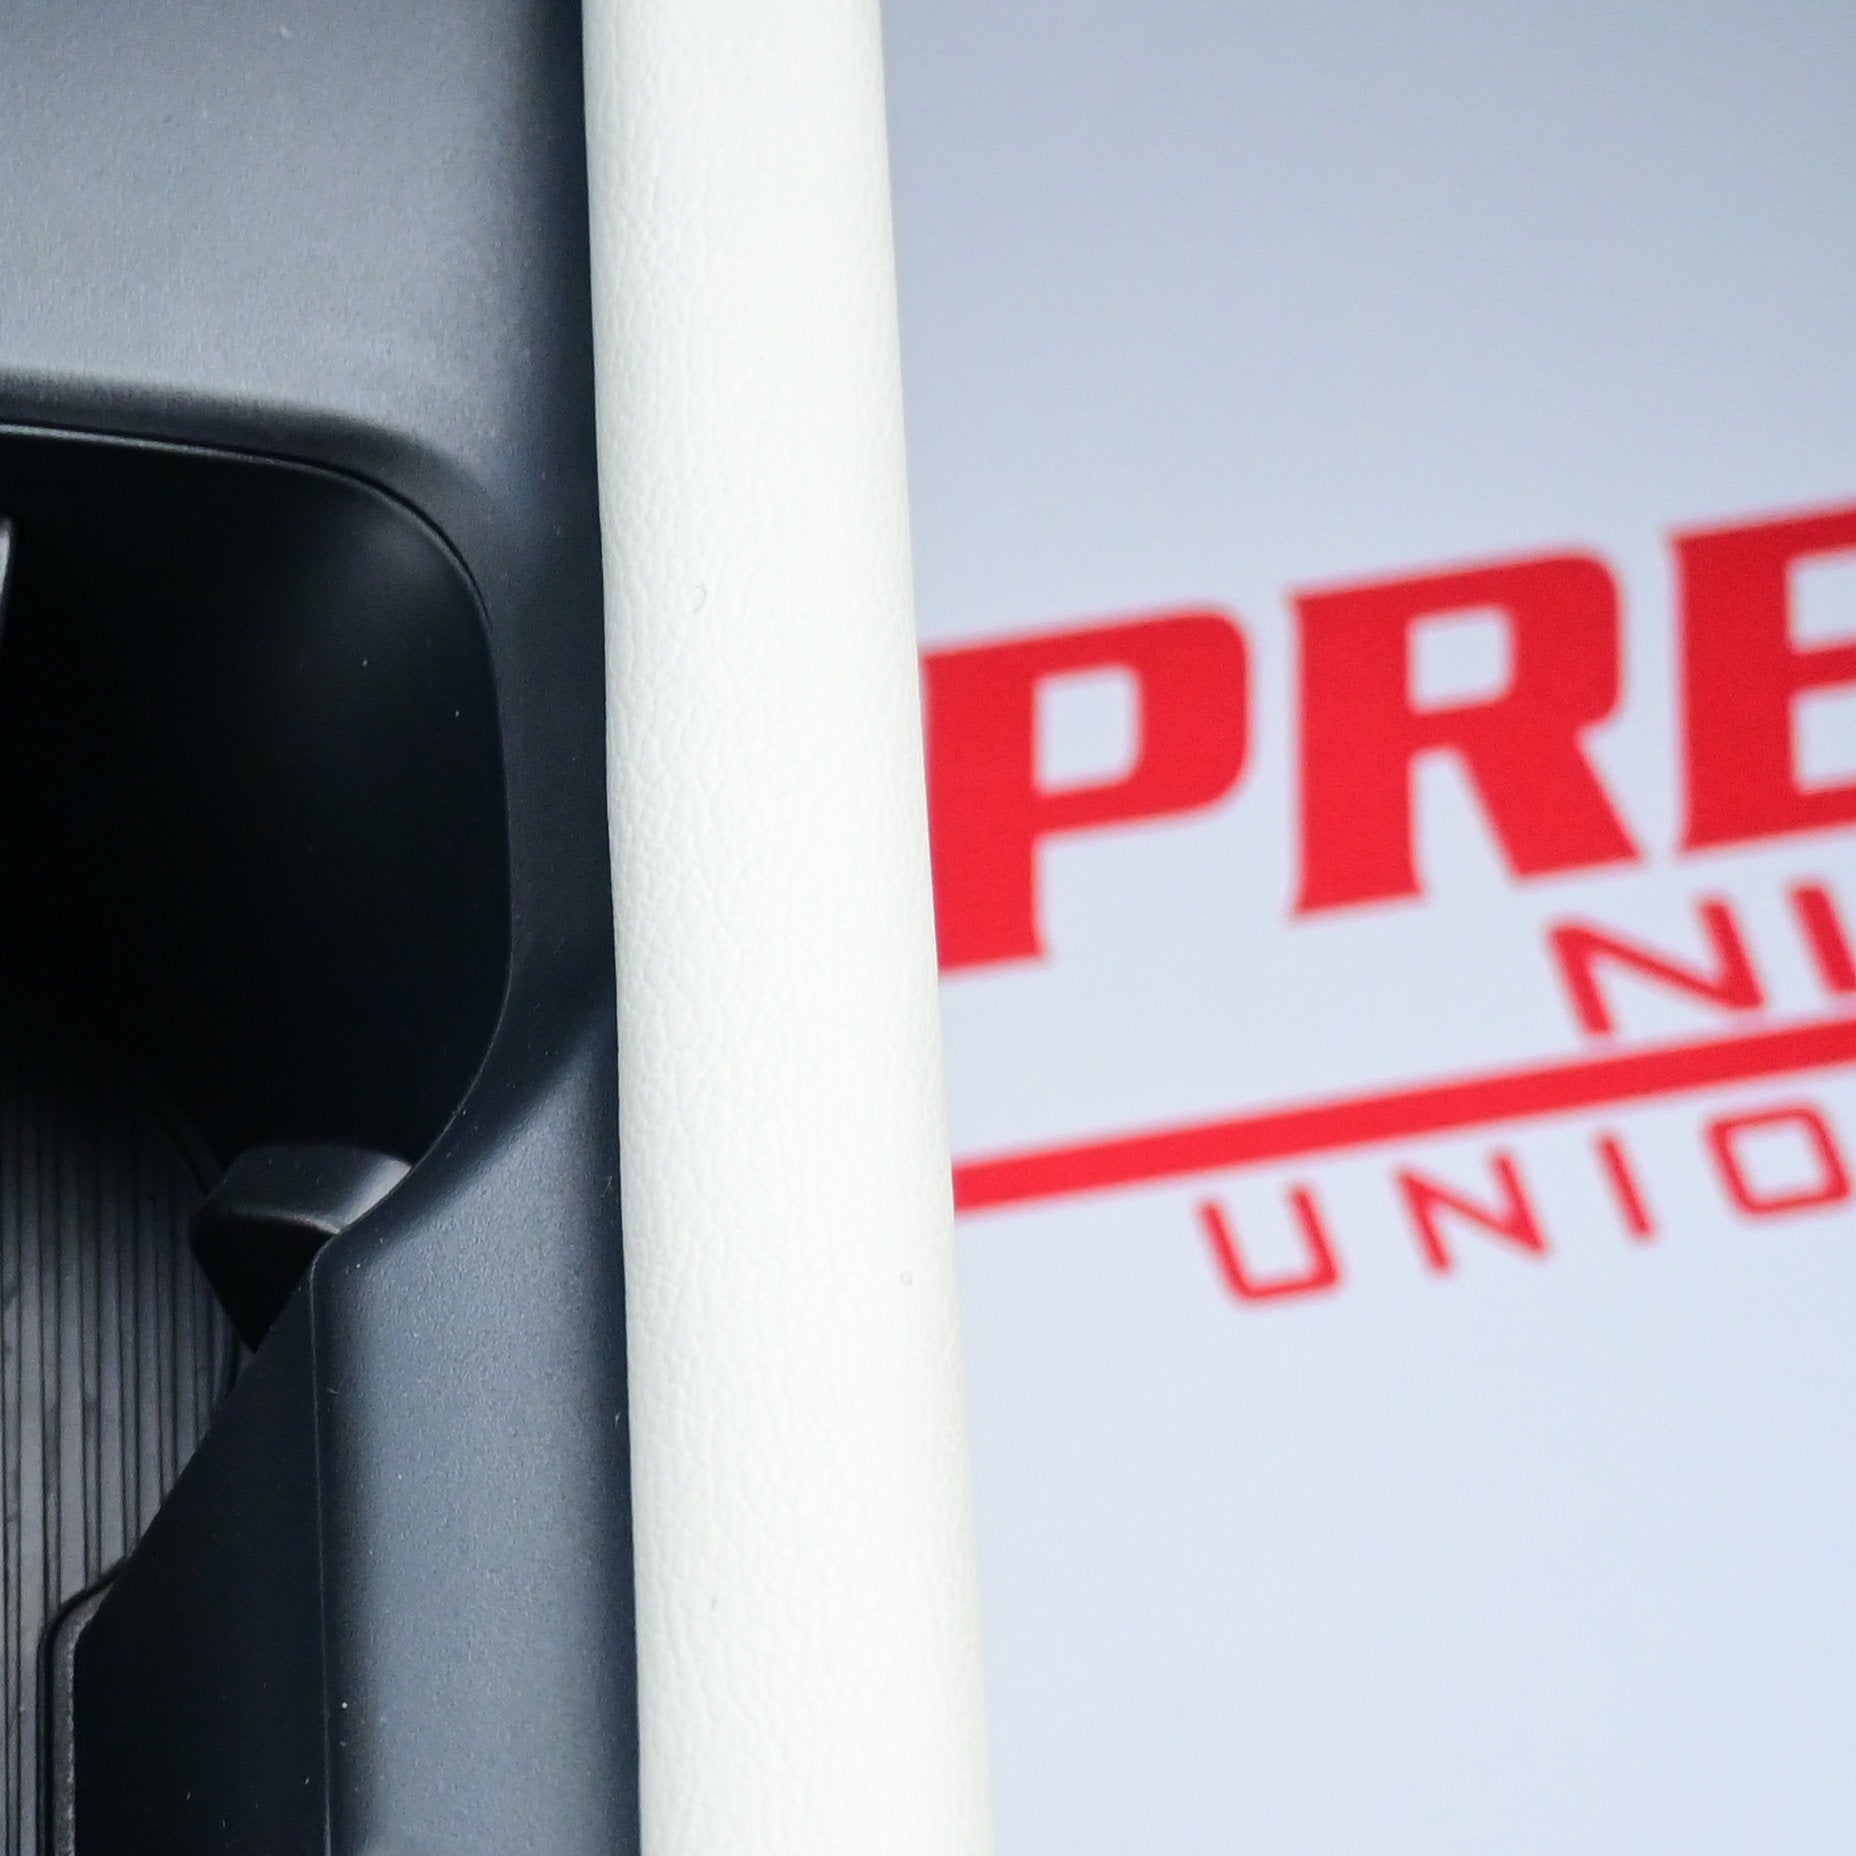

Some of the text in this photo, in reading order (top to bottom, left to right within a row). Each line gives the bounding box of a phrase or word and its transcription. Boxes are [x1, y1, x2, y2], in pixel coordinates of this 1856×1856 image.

[920, 500, 1856, 978] PRE
[1546, 882, 1856, 1038] NI
[1196, 1103, 1852, 1305] UNIO
